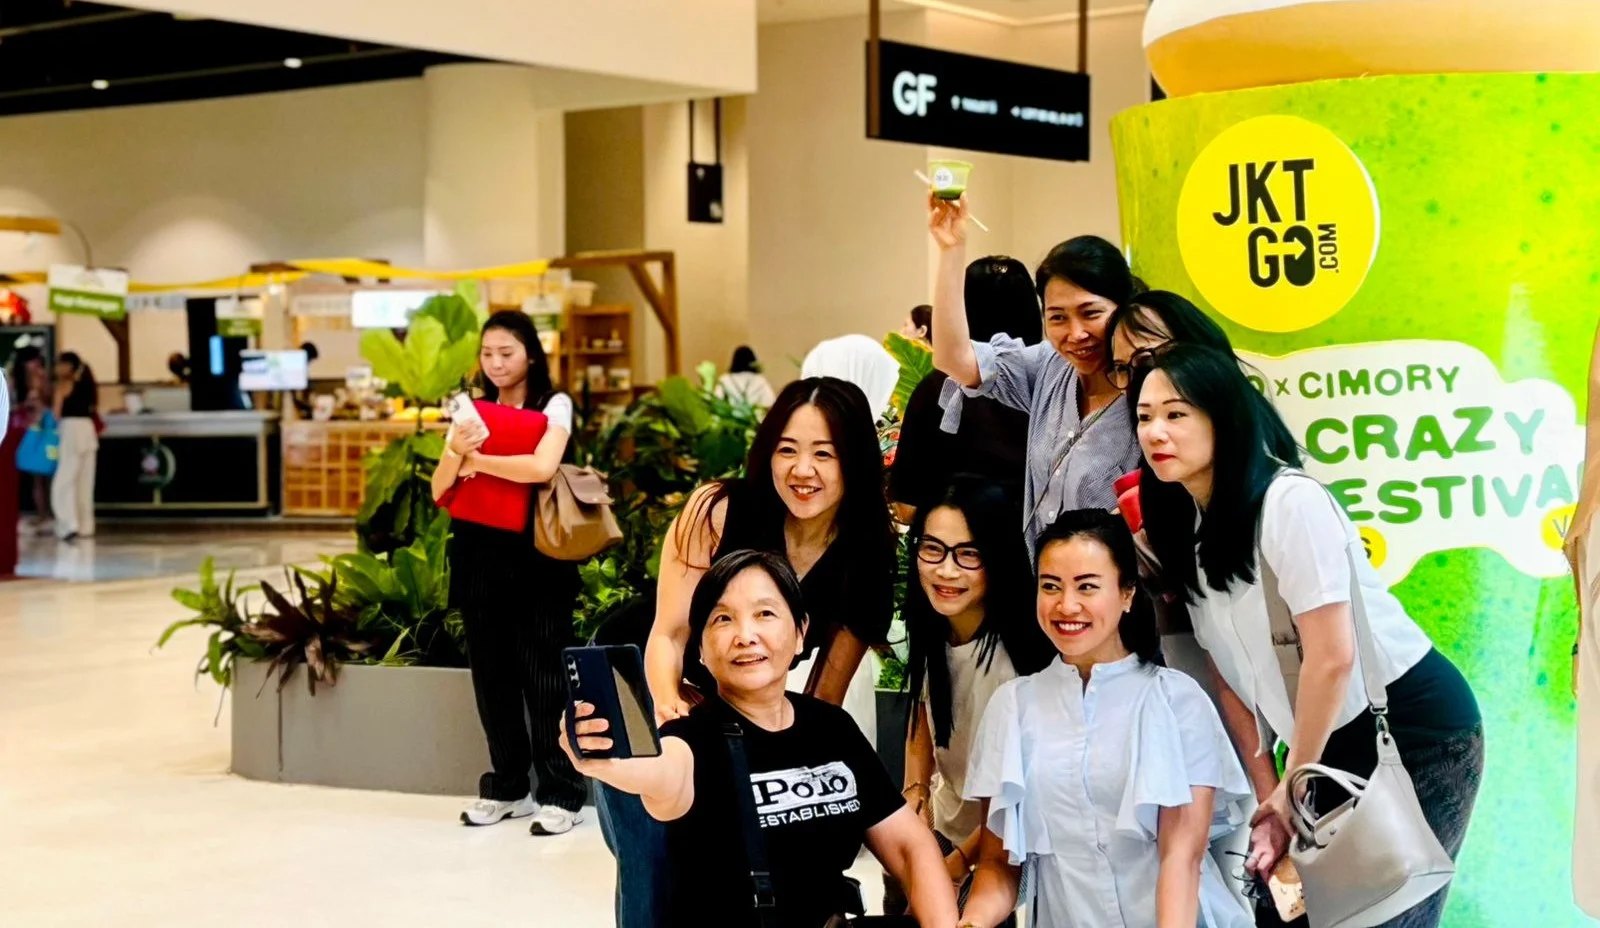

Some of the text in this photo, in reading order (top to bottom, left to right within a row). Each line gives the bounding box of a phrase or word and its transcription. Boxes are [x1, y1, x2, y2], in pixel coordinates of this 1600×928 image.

[893, 70, 938, 117] GF
[1212, 158, 1315, 226] JKT
[1247, 225, 1316, 288] GO
[1317, 223, 1340, 273] .COM
[1299, 364, 1460, 398] CIMORY
[1305, 406, 1545, 464] CRAZY
[1326, 461, 1585, 524] ESTIVA
